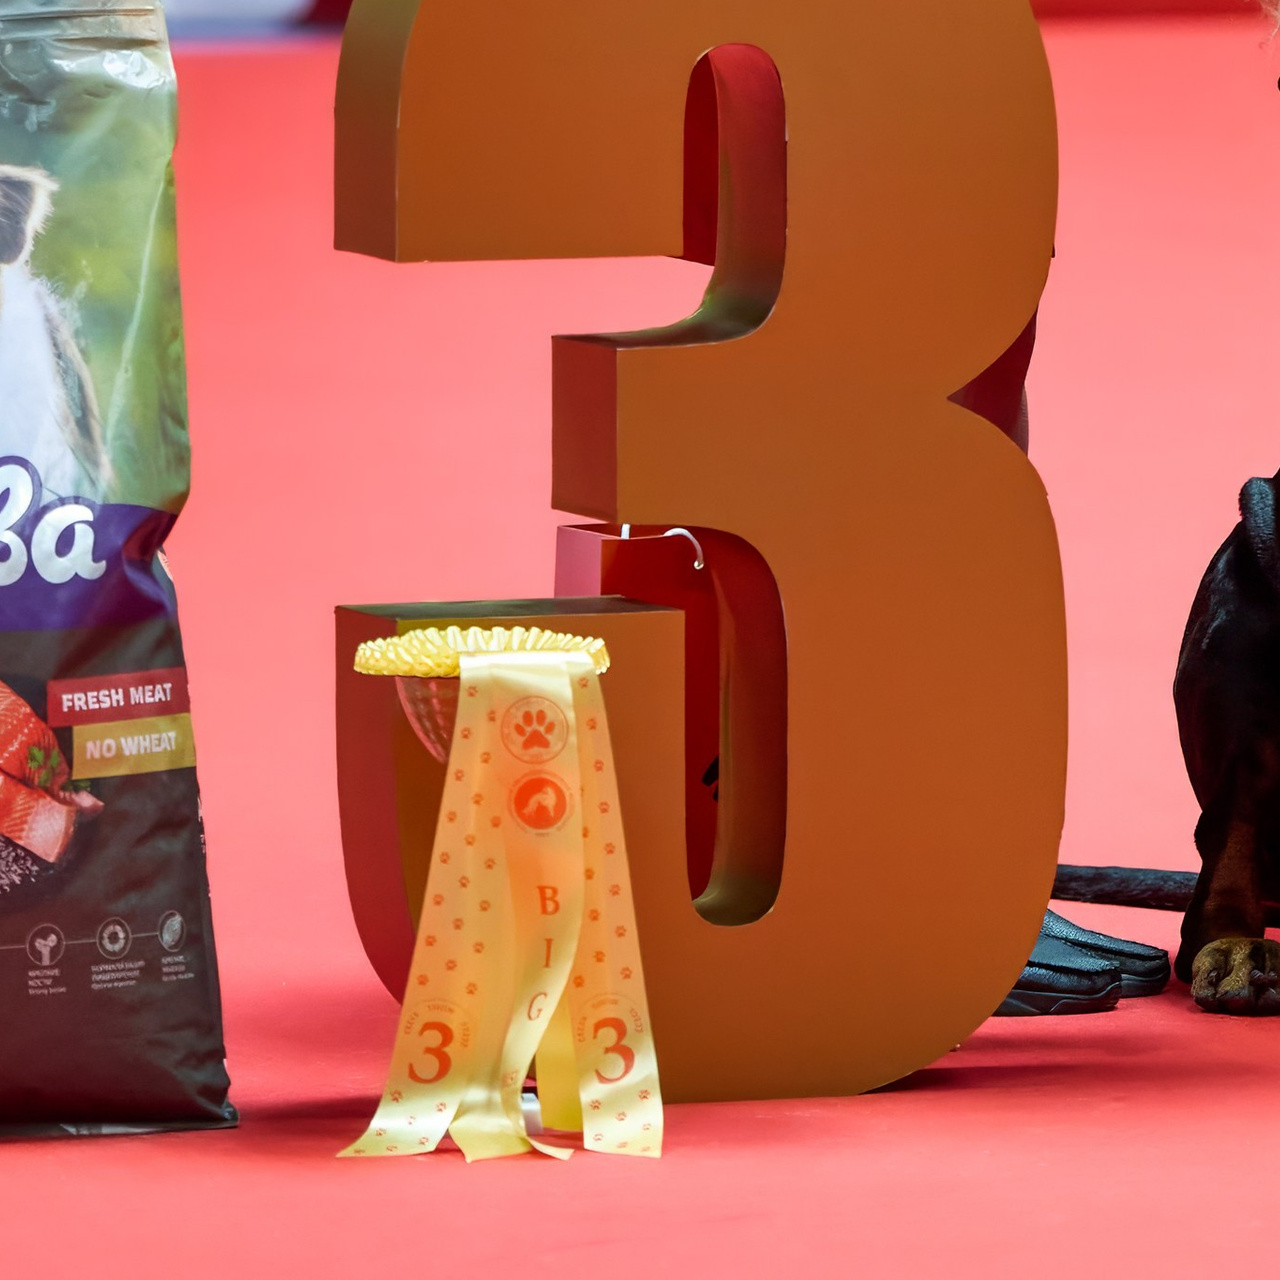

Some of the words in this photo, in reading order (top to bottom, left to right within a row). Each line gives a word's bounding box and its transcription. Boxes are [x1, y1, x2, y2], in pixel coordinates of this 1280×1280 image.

[61, 687, 125, 712] FRESH
[129, 682, 173, 706] MEAT
[86, 738, 117, 760] NO
[120, 731, 177, 756] WHEAT
[408, 1021, 454, 1084] 3
[592, 1017, 635, 1084] 3
